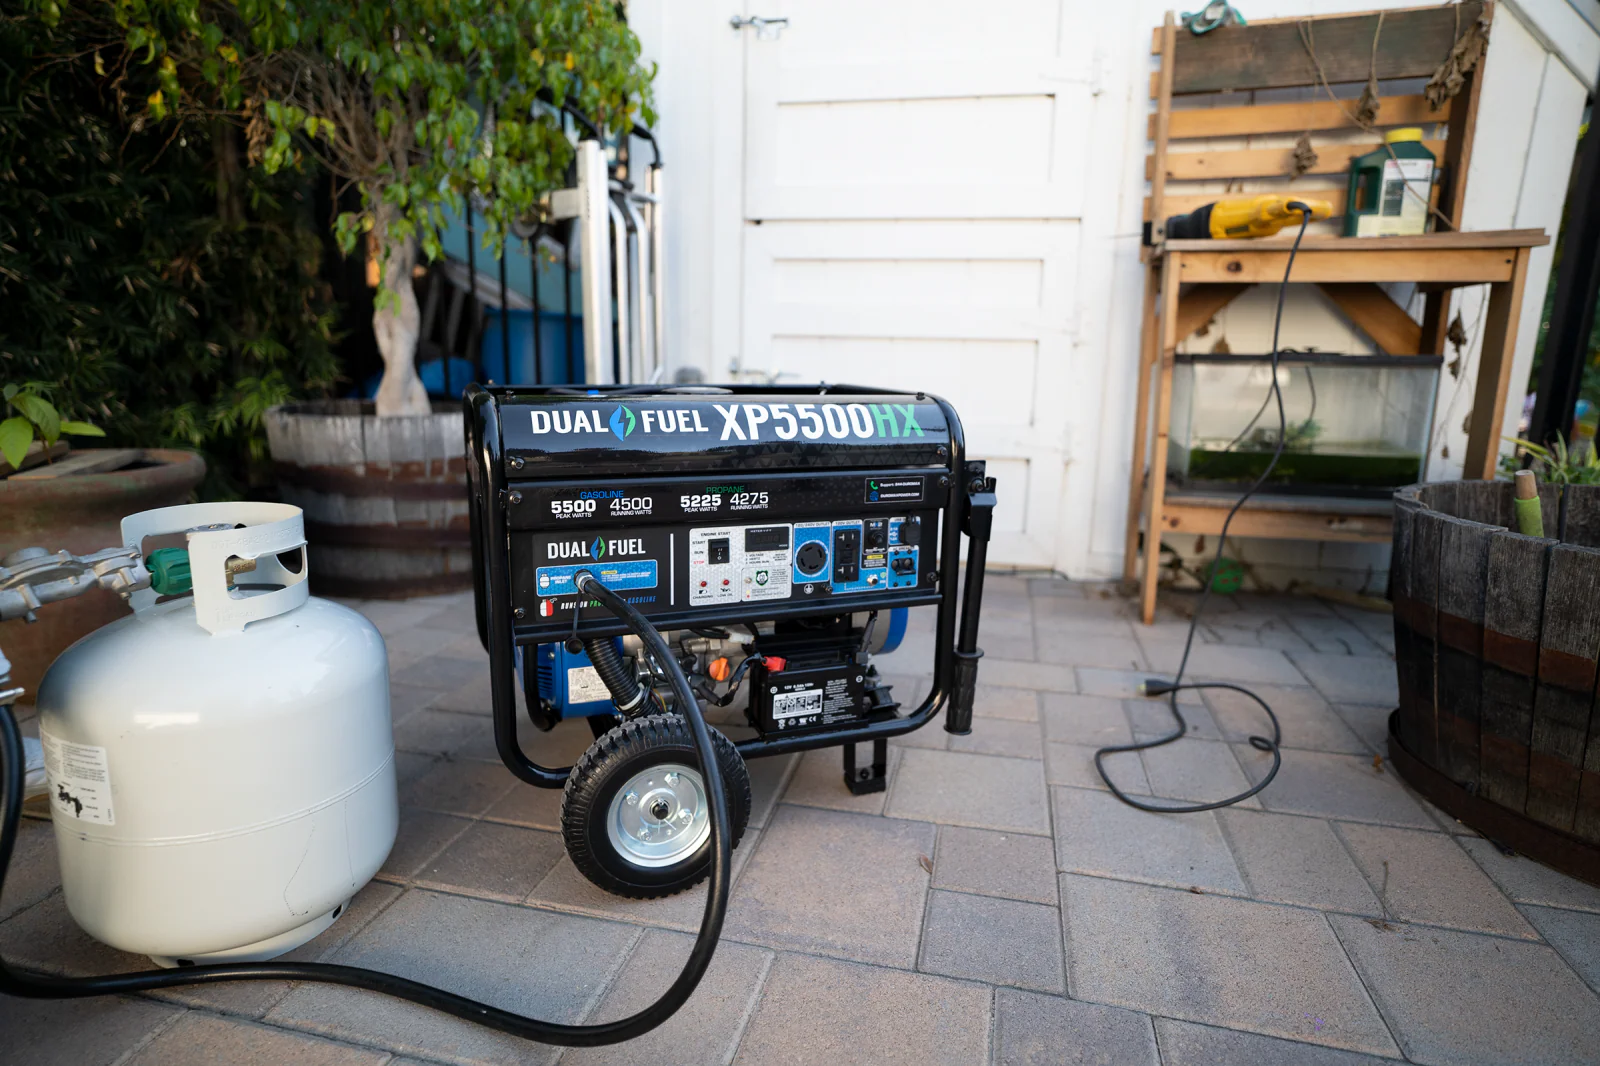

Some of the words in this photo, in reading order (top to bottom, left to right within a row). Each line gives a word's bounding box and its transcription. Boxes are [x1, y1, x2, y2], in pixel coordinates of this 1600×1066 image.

[530, 410, 609, 434] DUAL
[640, 409, 709, 433] FUEL
[712, 403, 926, 441] XP5500HX
[580, 490, 624, 499] GASOLINE
[706, 485, 745, 494] PROPANE
[551, 499, 596, 513] 5500
[610, 497, 652, 511] 4500
[680, 494, 721, 508] 5225
[730, 491, 769, 505] 4275
[547, 541, 590, 559] DUAL
[608, 538, 646, 556] FUEL
[627, 596, 657, 604] GASOLINE
